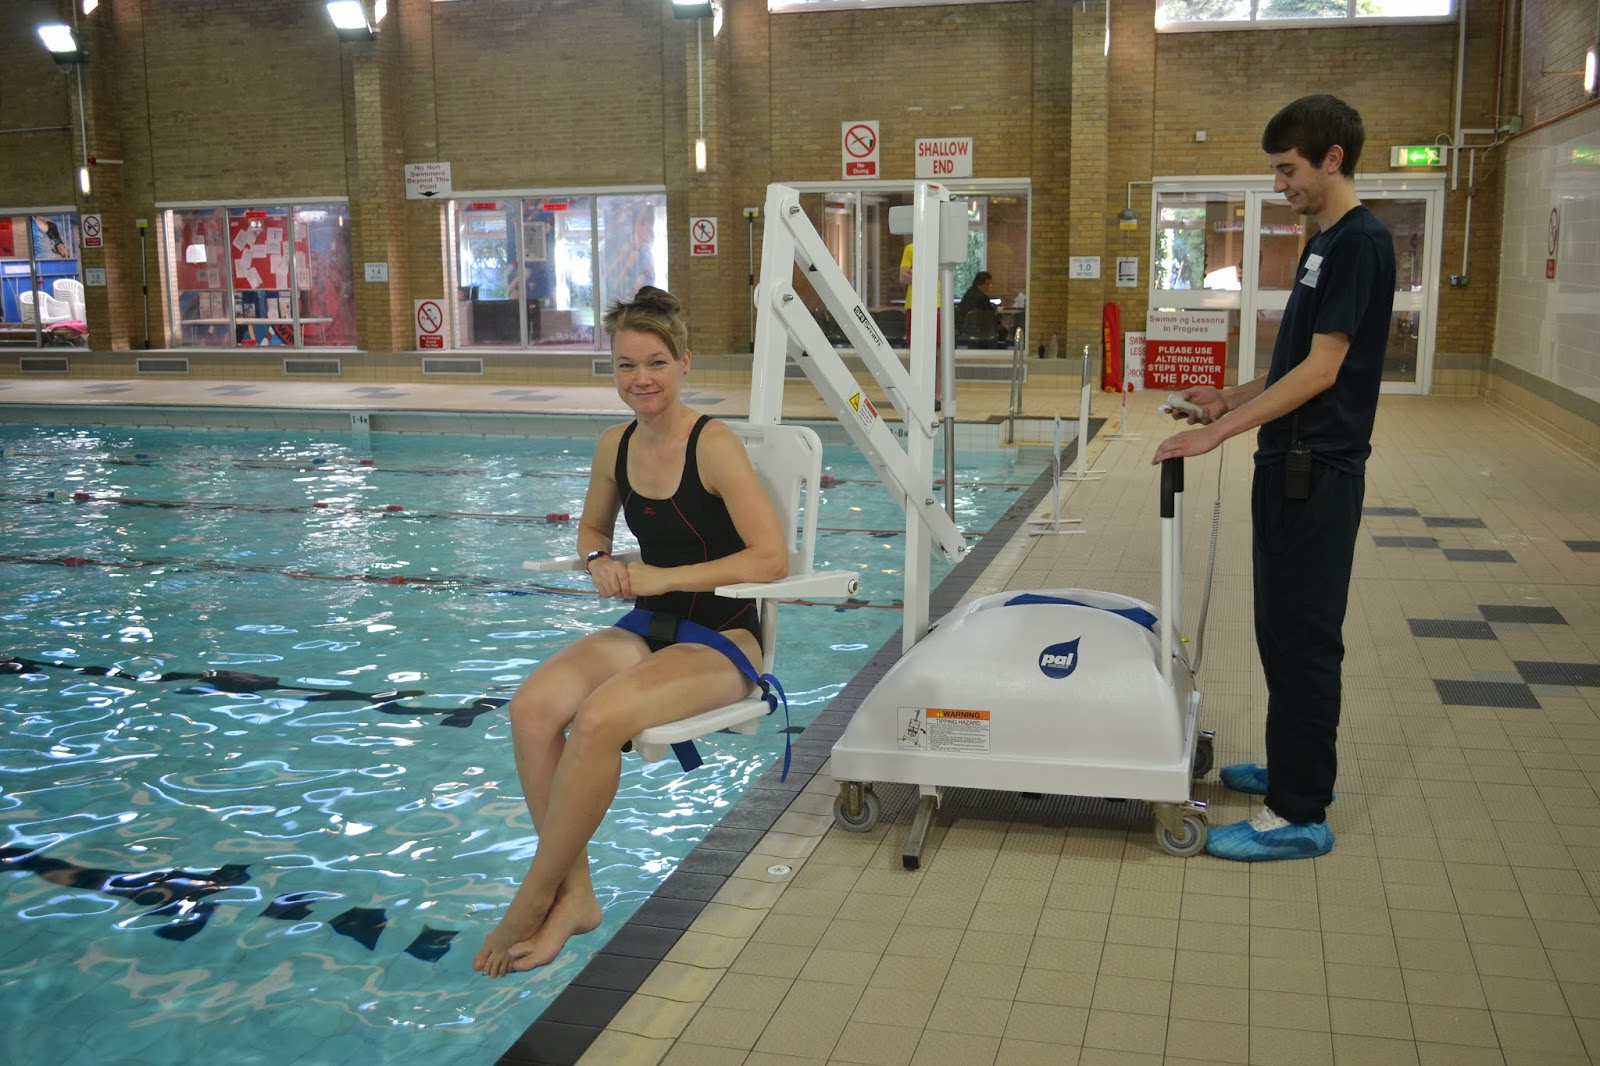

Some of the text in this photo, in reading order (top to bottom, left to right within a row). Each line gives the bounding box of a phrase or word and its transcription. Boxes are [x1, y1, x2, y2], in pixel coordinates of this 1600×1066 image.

[918, 141, 969, 157] SHALLOW
[932, 160, 954, 174] END
[1173, 325, 1209, 334] Progress
[1158, 346, 1212, 355] PLEASE USE
[1155, 356, 1214, 364] ALTERNATIVE
[1147, 364, 1176, 372] STEPS
[1191, 365, 1222, 373] ENTER
[1152, 373, 1216, 385] THE POOL
[1041, 652, 1074, 666] pal
[943, 710, 981, 719] WARNING
